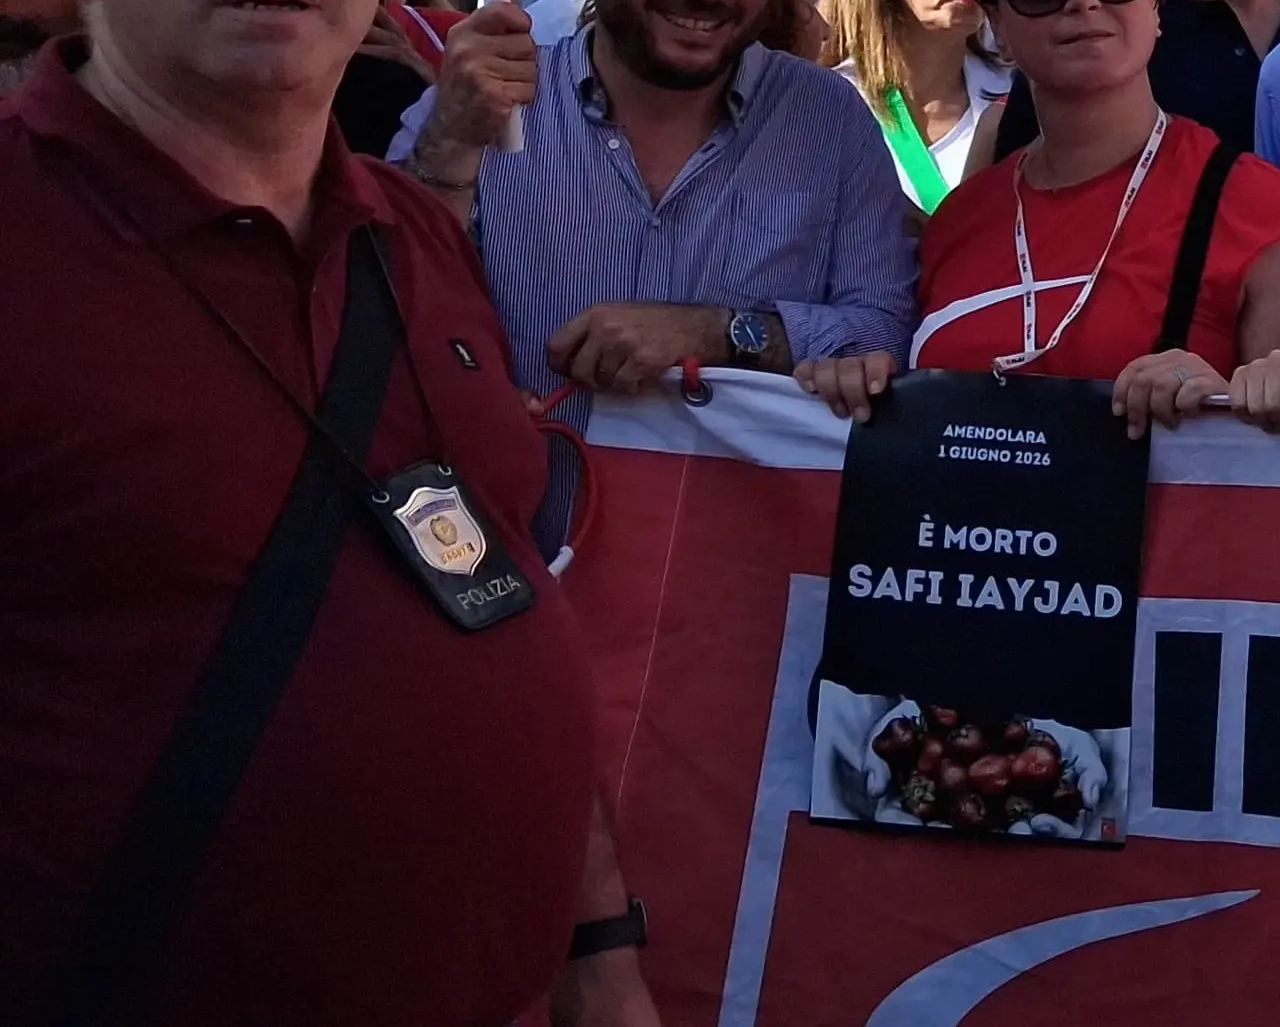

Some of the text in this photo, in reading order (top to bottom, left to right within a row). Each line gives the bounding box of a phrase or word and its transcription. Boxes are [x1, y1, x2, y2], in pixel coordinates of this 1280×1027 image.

[943, 424, 1047, 444] AMENDOLARA
[938, 445, 1051, 466] 1 GIUGNO 2026
[918, 514, 1057, 557] È MORTO
[456, 574, 521, 610] POLIZIA
[848, 563, 1123, 618] SAFI IAYJAD
